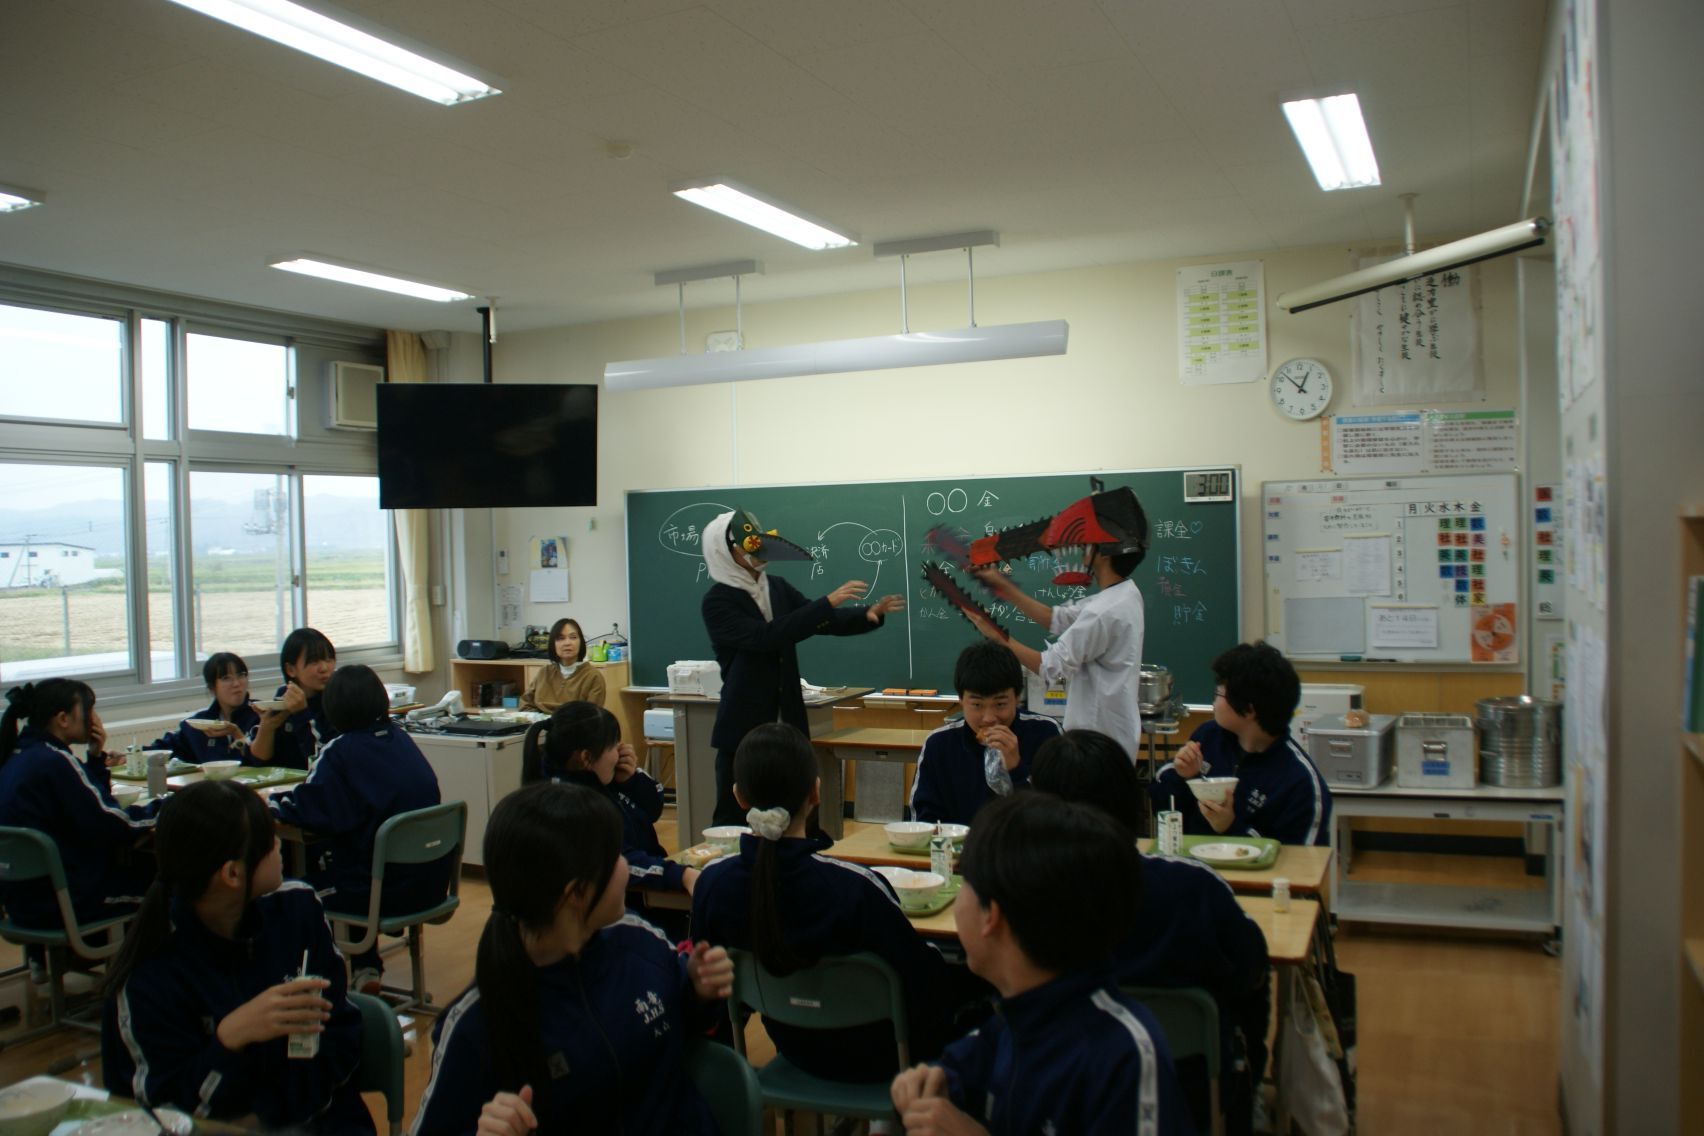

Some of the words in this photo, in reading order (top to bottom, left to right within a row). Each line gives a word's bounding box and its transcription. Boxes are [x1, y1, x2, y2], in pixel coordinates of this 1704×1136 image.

[1408, 503, 1417, 515] 月
[1424, 503, 1436, 514] 火
[1439, 502, 1450, 513] 水
[1453, 501, 1465, 513] 木
[1470, 500, 1482, 513] 金
[1439, 517, 1451, 529] 理
[1455, 516, 1467, 528] 理
[663, 523, 699, 546] 市場
[1455, 533, 1468, 544] 社
[1537, 549, 1552, 561] 理
[1157, 555, 1207, 575] ぼきん
[1471, 564, 1483, 575] 理
[1455, 593, 1467, 605] 体
[1173, 600, 1208, 625] 貯金
